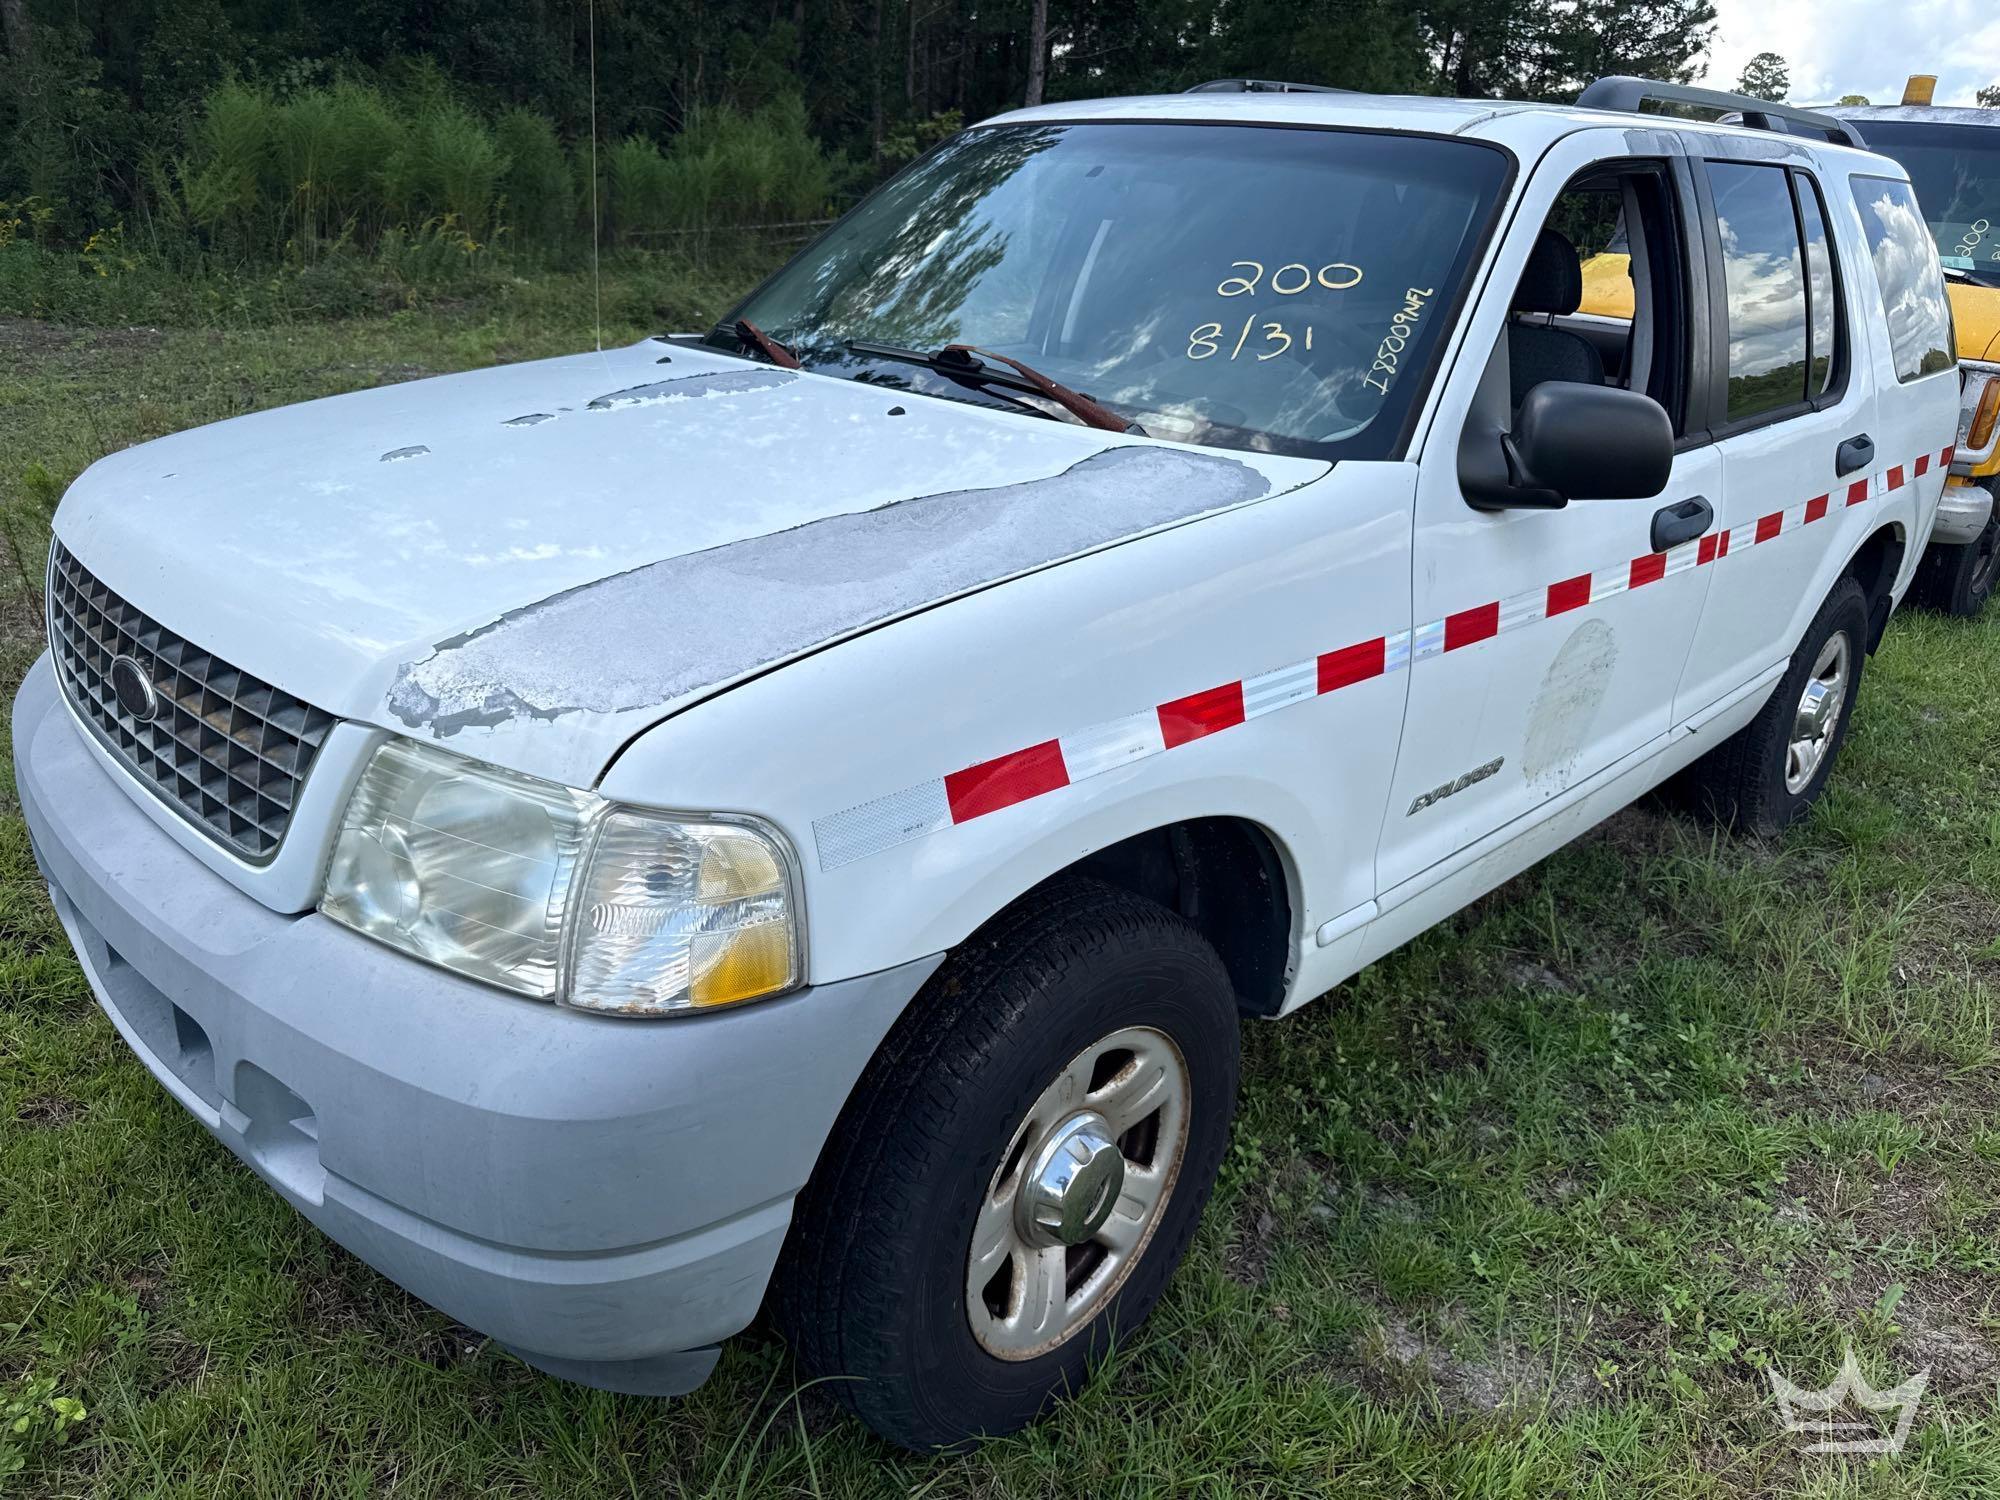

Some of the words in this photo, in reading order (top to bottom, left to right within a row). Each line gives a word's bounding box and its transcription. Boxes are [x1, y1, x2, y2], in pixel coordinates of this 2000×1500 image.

[1954, 219, 1989, 257] 200
[1217, 261, 1363, 296] 200
[1187, 313, 1313, 361] 8/31
[1406, 755, 1504, 816] EXPLORER
